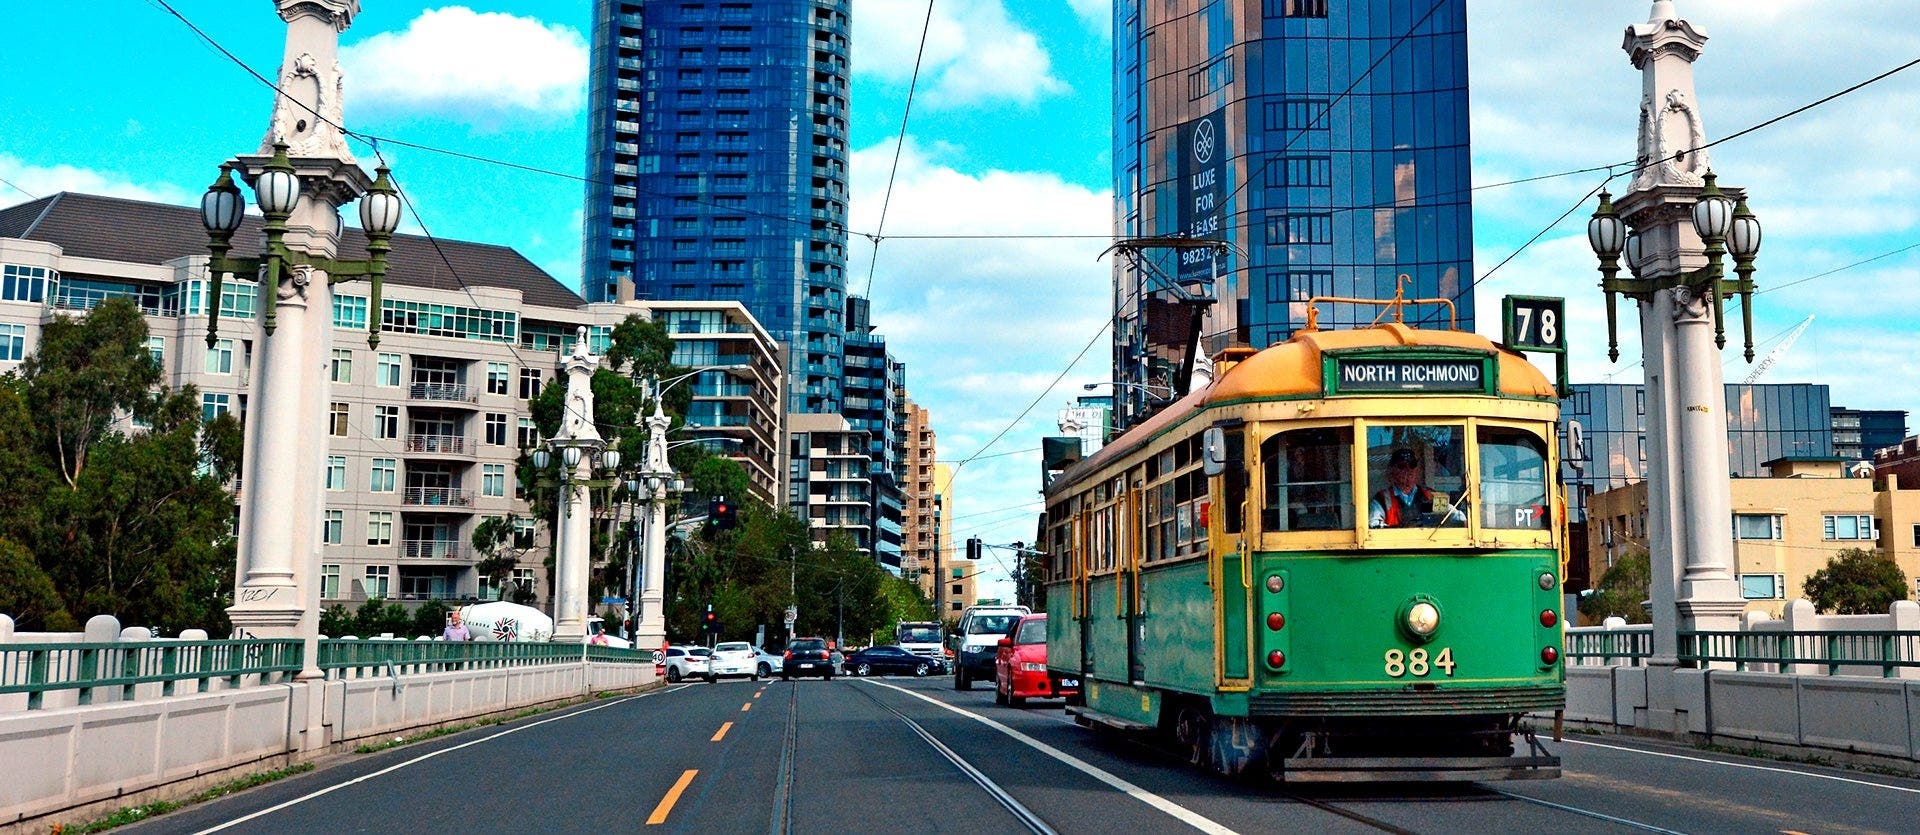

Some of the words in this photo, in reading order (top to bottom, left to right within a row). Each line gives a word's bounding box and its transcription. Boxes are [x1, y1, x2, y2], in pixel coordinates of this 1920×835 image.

[1192, 168, 1216, 191] LUXE
[1195, 192, 1214, 214] FOR
[1190, 215, 1218, 239] LEASE
[1182, 247, 1205, 265] 9823
[1516, 307, 1557, 344] 78
[1344, 364, 1396, 382] NORTH
[1401, 364, 1480, 382] RICHMOND
[651, 653, 664, 662] 40
[1384, 647, 1455, 677] 884
